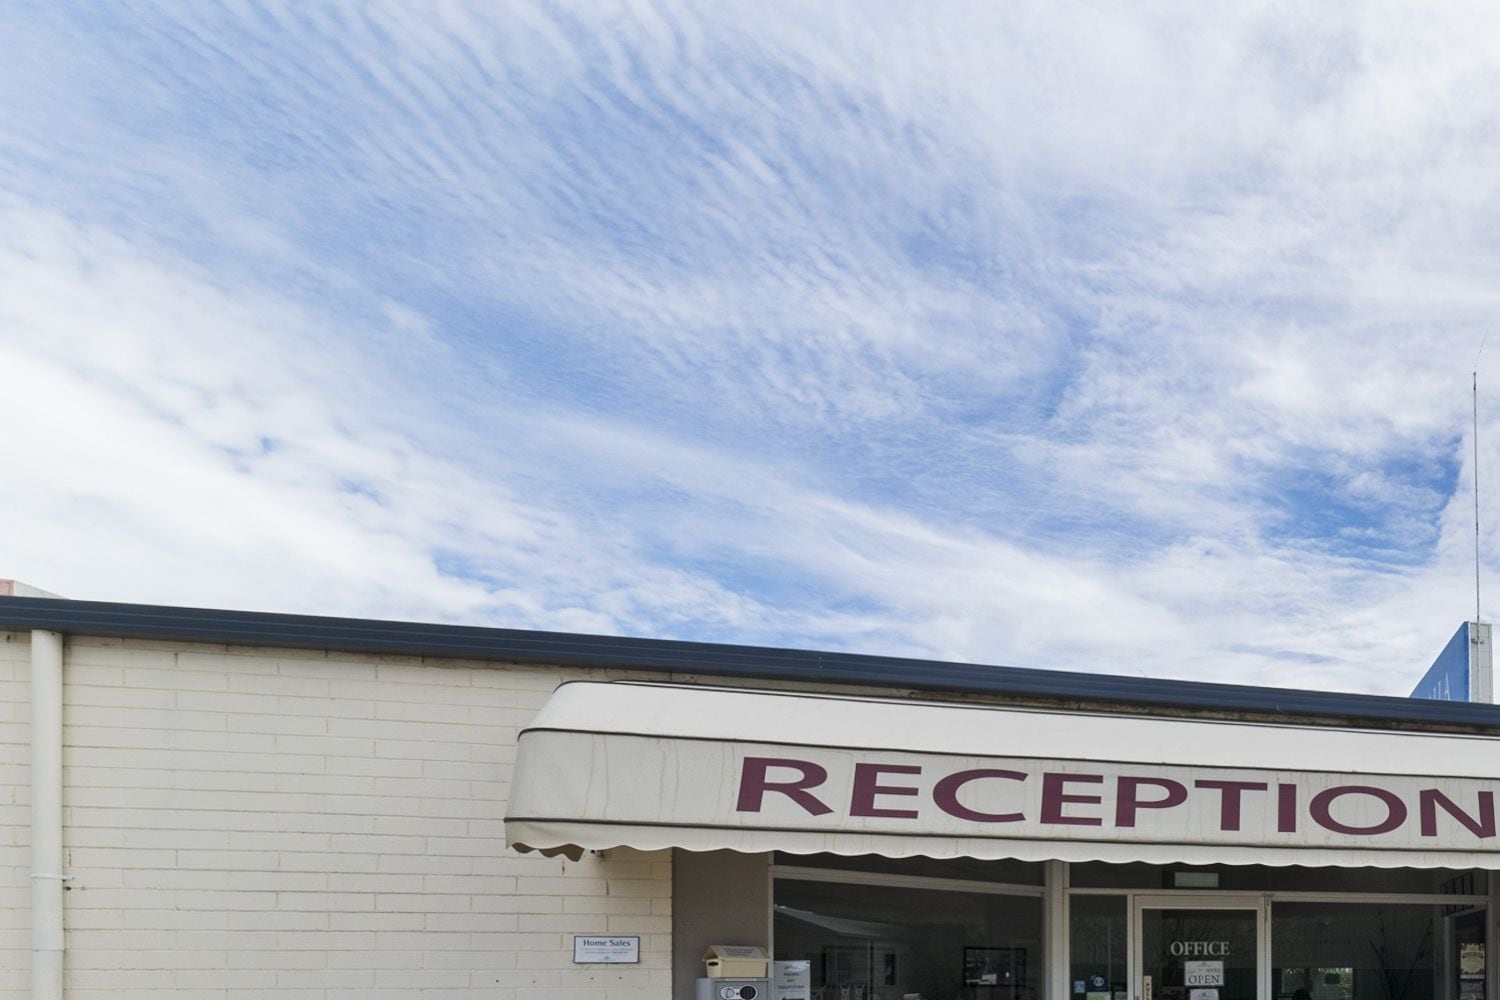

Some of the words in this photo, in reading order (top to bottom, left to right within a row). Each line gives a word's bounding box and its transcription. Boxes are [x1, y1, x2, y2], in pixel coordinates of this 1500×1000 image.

[735, 756, 1497, 839] RECEPTION
[1170, 941, 1230, 956] OFFICE
[1188, 975, 1220, 985] OPEN
